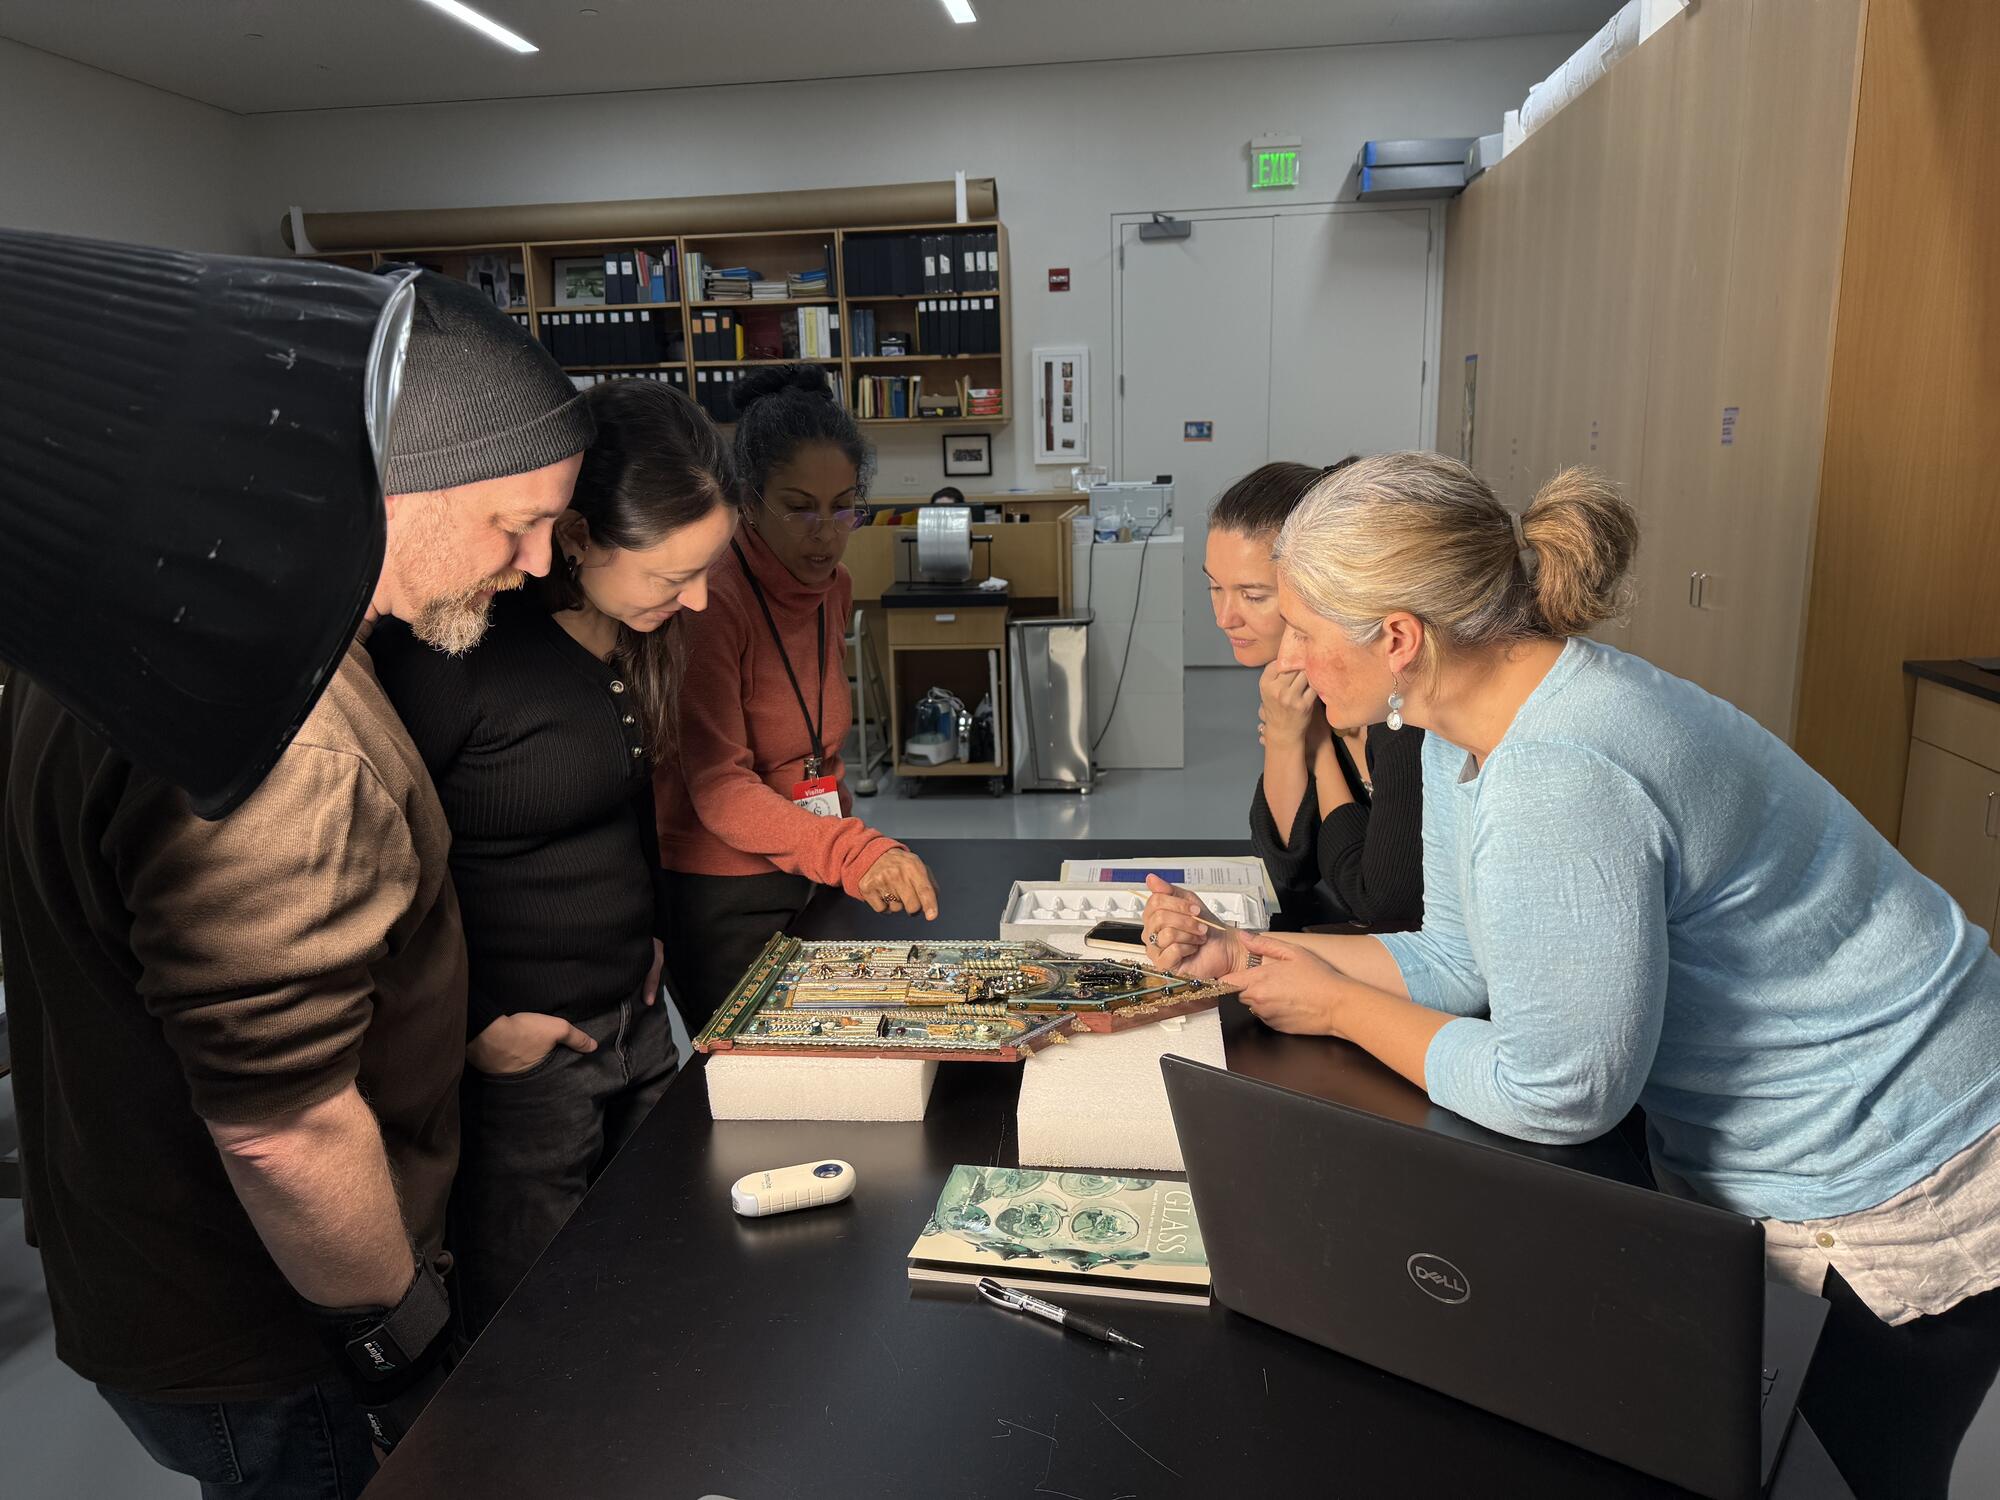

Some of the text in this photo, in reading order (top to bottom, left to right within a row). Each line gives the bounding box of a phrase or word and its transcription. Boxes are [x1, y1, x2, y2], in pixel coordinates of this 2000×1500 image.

[1258, 152, 1297, 185] EXIT
[804, 788, 826, 797] Visitor
[1156, 1190, 1193, 1254] GLASS
[1415, 1265, 1465, 1293] DELL
